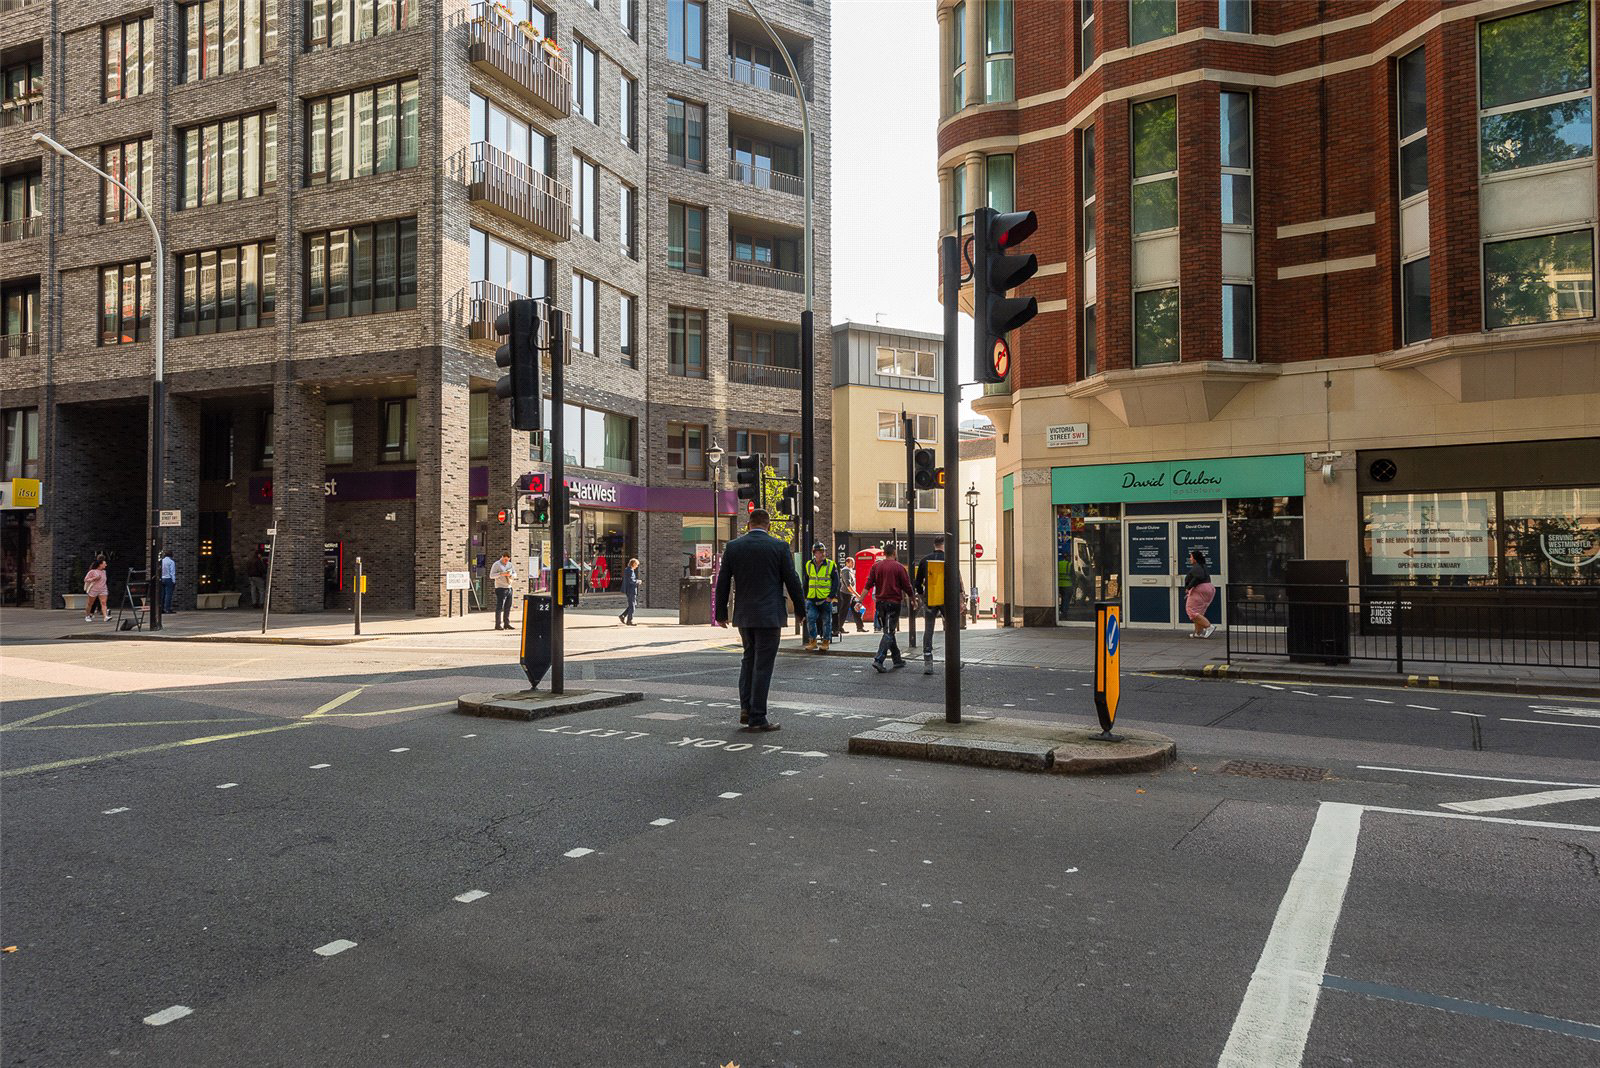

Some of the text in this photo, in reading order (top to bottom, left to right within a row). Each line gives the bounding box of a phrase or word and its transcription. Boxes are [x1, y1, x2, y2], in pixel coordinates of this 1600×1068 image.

[1122, 469, 1221, 488] David Clulow
[18, 488, 36, 497] itsu
[570, 481, 616, 502] NatWest
[538, 726, 783, 755] LOOK LEFT
